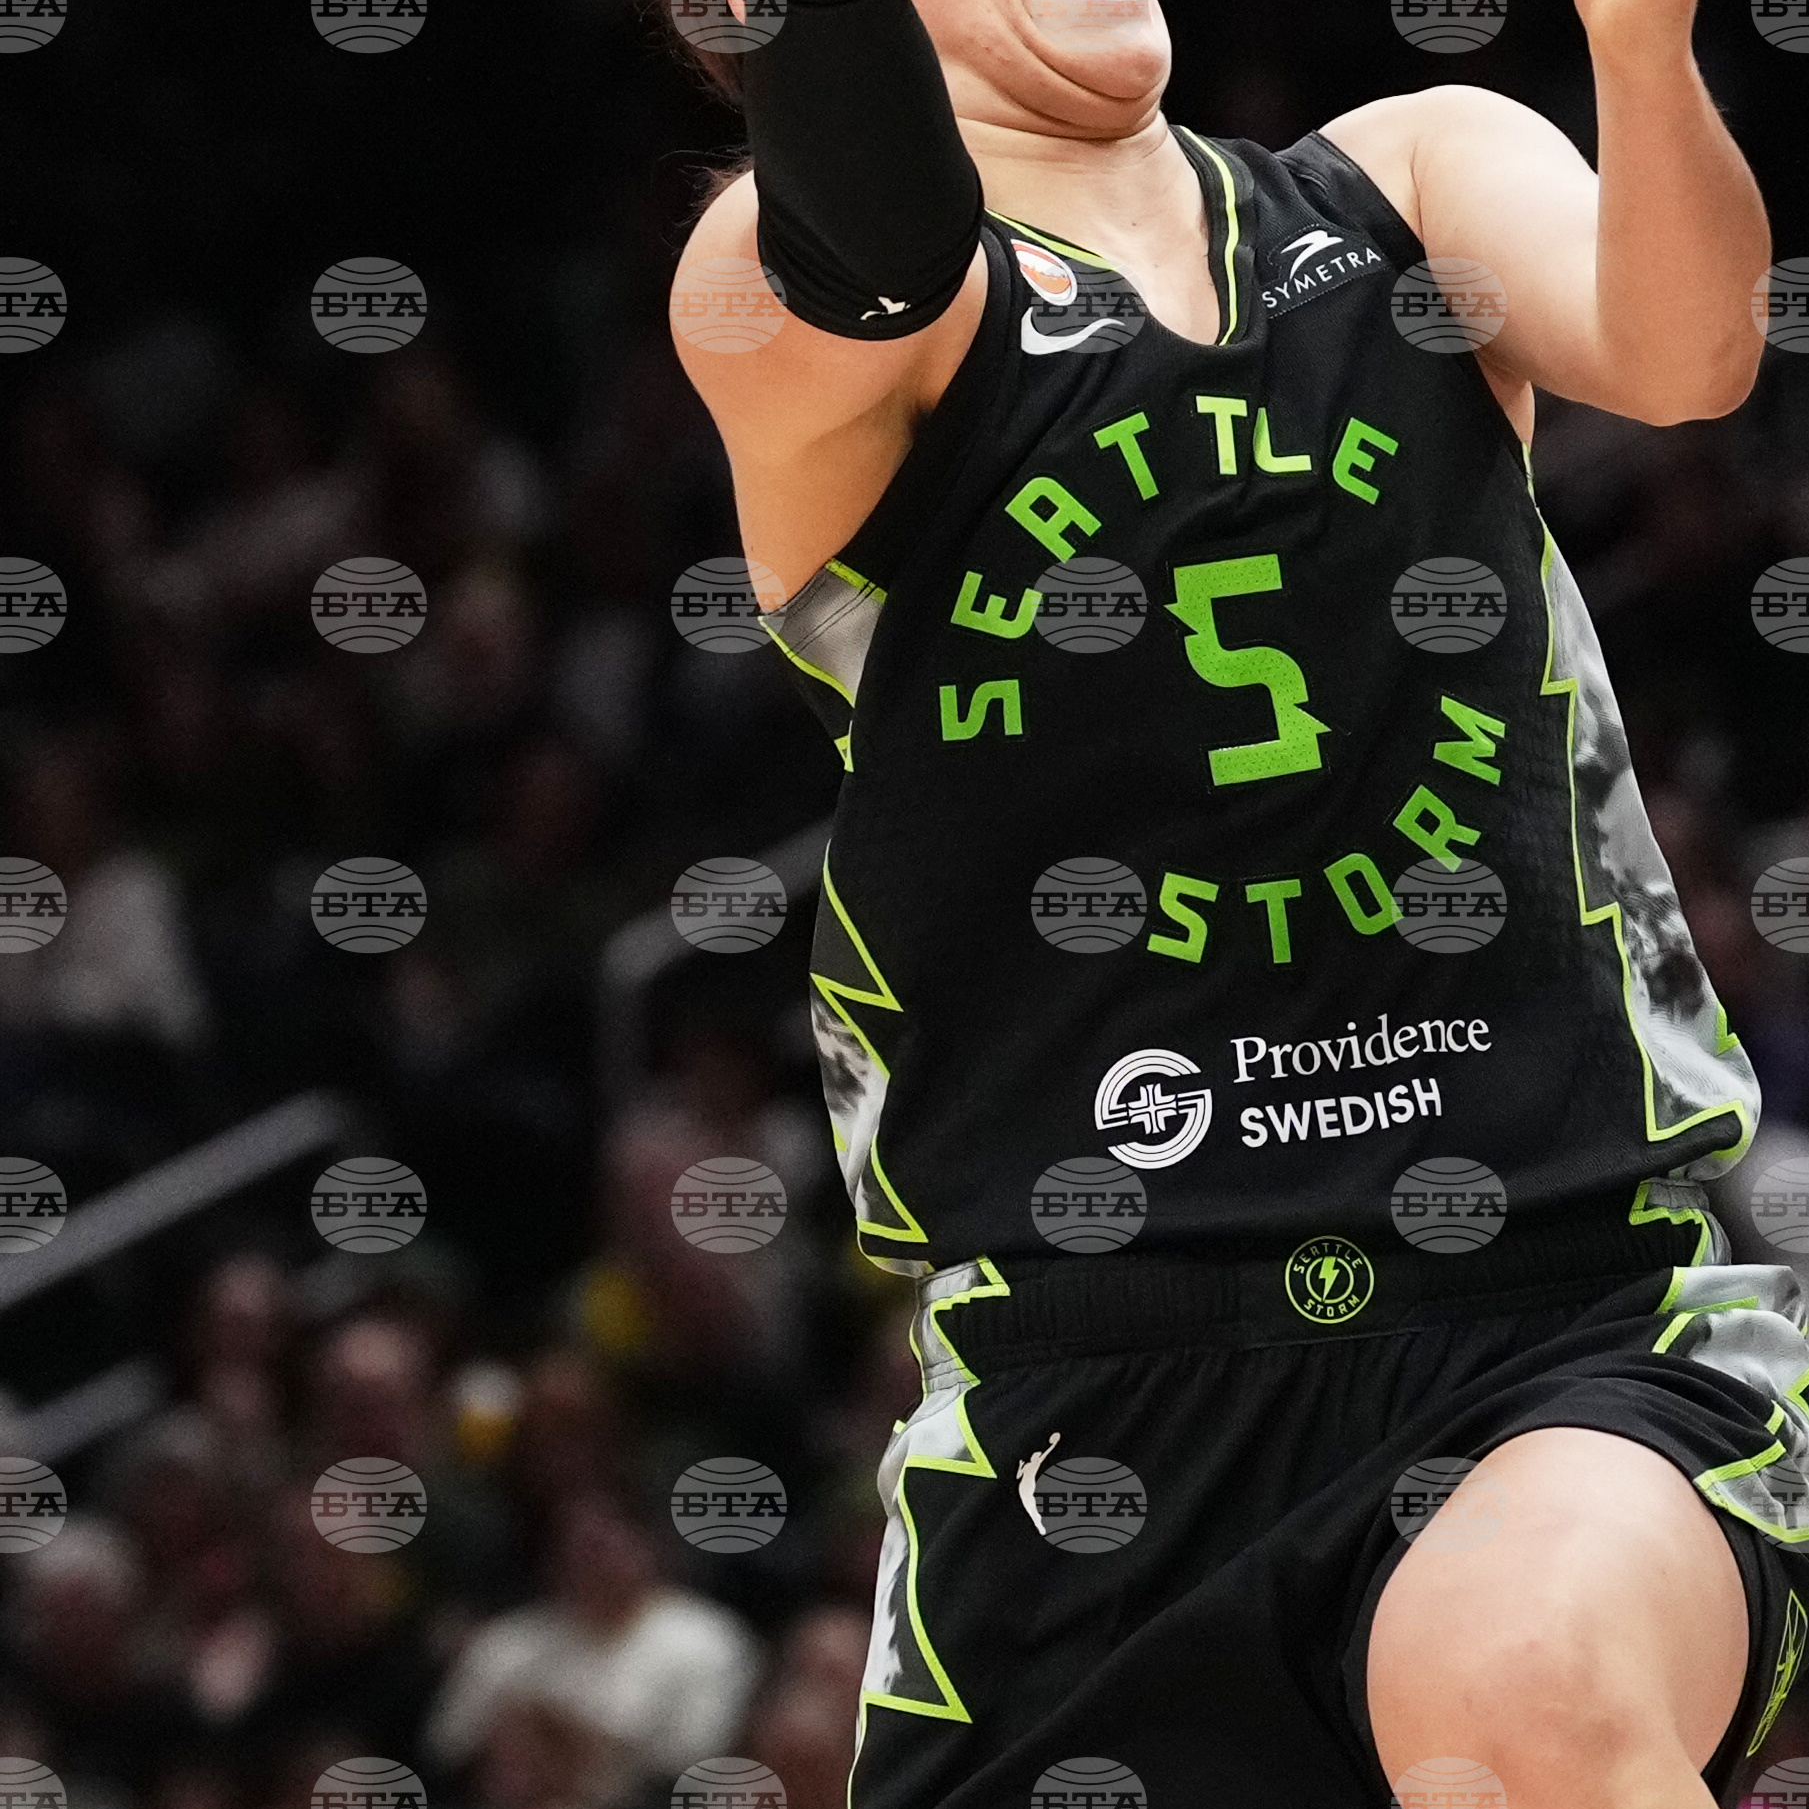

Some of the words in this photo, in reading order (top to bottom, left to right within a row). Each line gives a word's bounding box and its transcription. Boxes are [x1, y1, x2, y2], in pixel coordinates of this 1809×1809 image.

[1261, 246, 1382, 309] SYMETRA
[939, 395, 1399, 742] SEATTLE
[1164, 553, 1332, 786] 5
[1146, 694, 1507, 964] STORM
[1229, 1013, 1492, 1083] Providence
[1239, 1077, 1443, 1148] SWEDISH
[1293, 1242, 1363, 1274] SEATTLE
[1303, 1294, 1360, 1318] STORM
